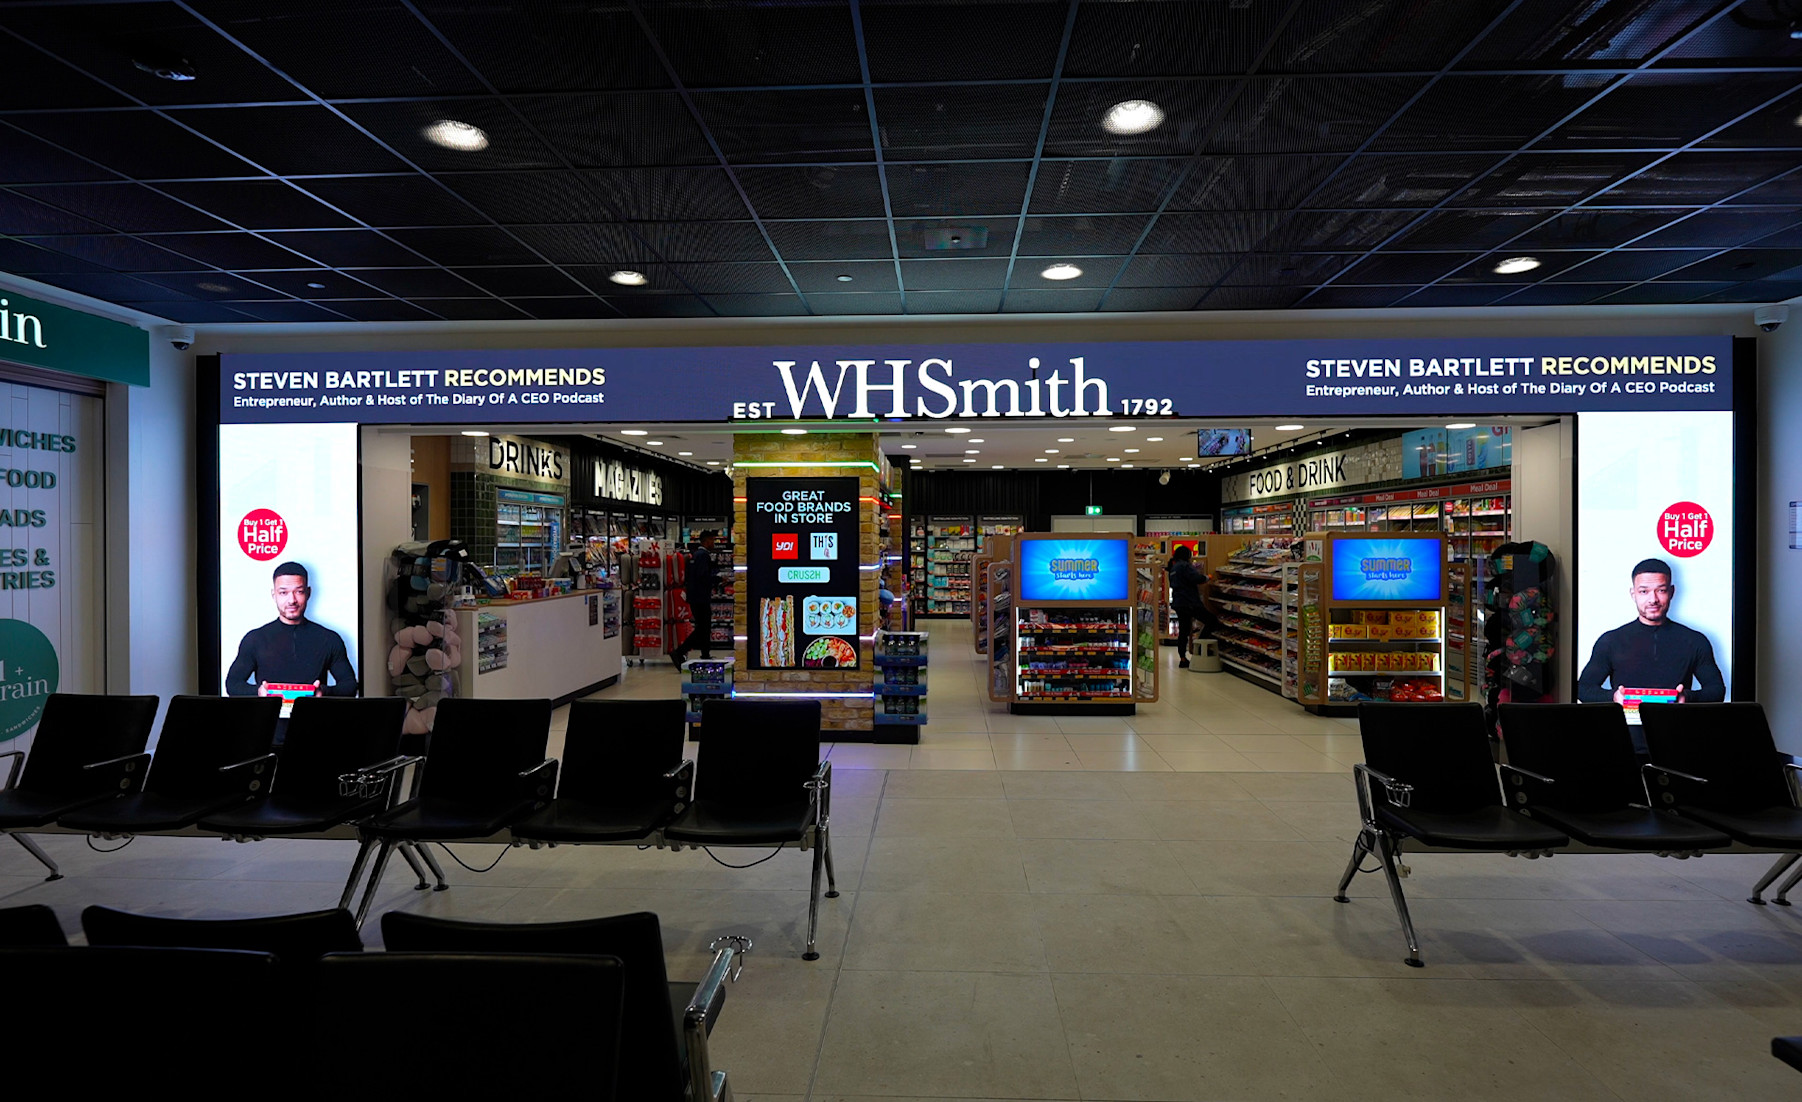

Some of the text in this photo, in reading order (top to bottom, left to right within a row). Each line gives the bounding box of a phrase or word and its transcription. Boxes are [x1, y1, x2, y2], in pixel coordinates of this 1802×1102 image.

[1306, 356, 1717, 378] STEVEN BARTLETT RECOMMENDS
[233, 368, 606, 390] STEVEN BARTLETT RECOMMENDS
[733, 357, 1174, 419] EST WHSmith 1792
[1306, 381, 1716, 398] Entrepreneur, Author & Host of The Diary Of A CEO Podcast
[233, 392, 605, 409] Entrepreneur, Author & Host of The Diary Of A CEO Podcast
[489, 436, 563, 480] DRINKS
[594, 460, 663, 506] MAGAZINES
[1250, 454, 1347, 496] FOOD & DRINK
[782, 490, 826, 501] GREAT
[1470, 482, 1498, 493] Meal Deal
[756, 502, 852, 513] FOOD BRANDS
[244, 518, 258, 527] Buy
[774, 513, 834, 524] IN STORE
[1664, 512, 1680, 521] Buy
[1688, 512, 1702, 520] Get
[244, 526, 284, 542] Half
[1664, 520, 1708, 538] Half
[248, 543, 279, 554] Price
[776, 541, 794, 551] YO!
[1668, 538, 1703, 550] Price
[34, 548, 50, 566] &
